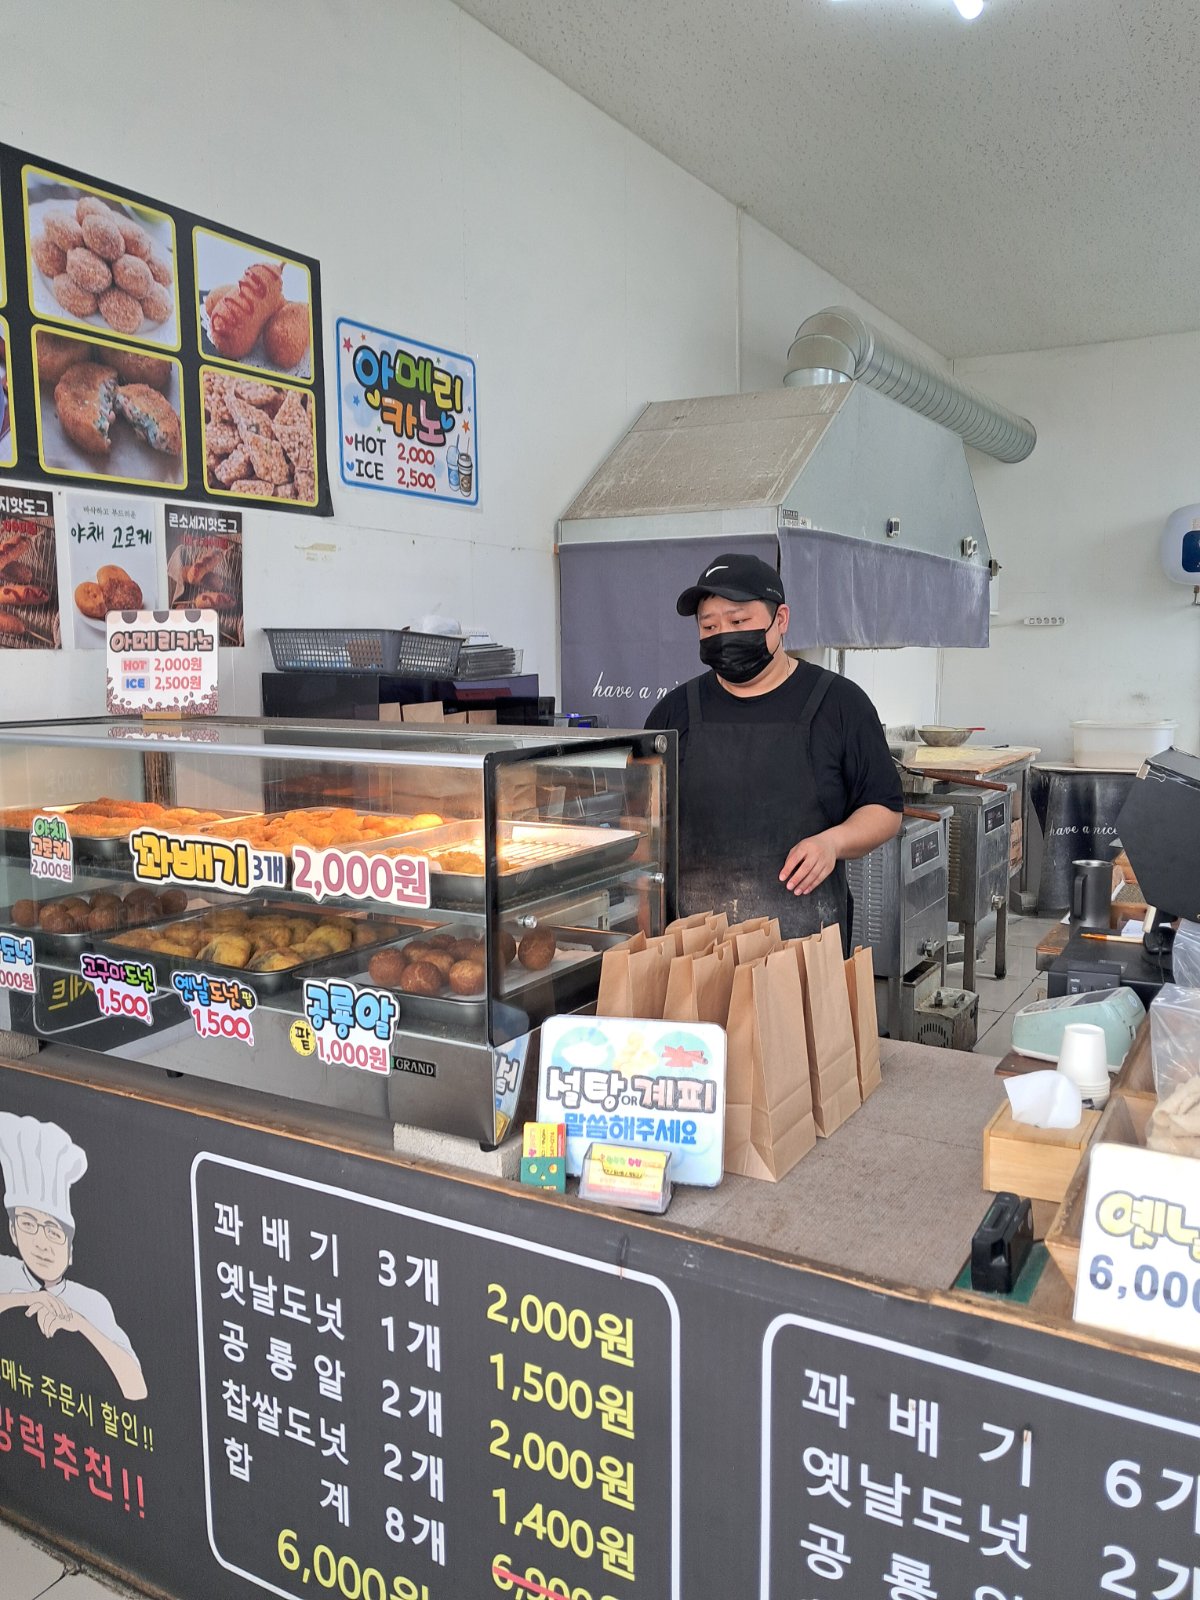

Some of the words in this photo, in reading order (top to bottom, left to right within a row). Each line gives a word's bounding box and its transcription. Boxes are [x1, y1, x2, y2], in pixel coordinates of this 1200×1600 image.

[355, 434, 386, 456] HOT
[355, 459, 384, 480] ICE
[71, 522, 104, 544] 야채
[112, 525, 152, 549] 고로케
[110, 629, 214, 652] 아메리카노
[123, 660, 147, 672] HOT
[154, 657, 202, 672] 2,000원
[125, 677, 146, 689] ICE
[154, 675, 202, 690] 2,500원
[592, 671, 634, 699] have
[639, 686, 651, 699] a
[34, 817, 67, 840] 야채
[1049, 819, 1079, 836] have
[1082, 825, 1091, 834] a
[31, 836, 71, 861] 고로케
[31, 859, 72, 880] 2,000원
[132, 831, 249, 887] 꽈배기
[253, 855, 283, 884] 3개
[294, 849, 427, 904] 2,000원
[0, 935, 33, 966] 도넛
[83, 956, 155, 993] 고구마도넛
[173, 974, 242, 1010] 옛날도넛
[306, 984, 395, 1040] 공룡알
[317, 1037, 387, 1072] 1,000원
[395, 1057, 434, 1076] GRAND
[547, 1066, 628, 1111] 설탕
[634, 1075, 717, 1112] 계피
[565, 1112, 697, 1146] 말씀해주세요
[487, 1284, 634, 1367] 2,000원
[216, 1261, 345, 1341] 옛날도넛
[489, 1353, 635, 1439] 1,500원
[0, 1358, 34, 1398] 메뉴
[41, 1375, 94, 1427] 주문시
[101, 1402, 154, 1452] 할인!!
[222, 1379, 349, 1465] 찹쌀도넛
[491, 1488, 635, 1581] 1,400원
[489, 1420, 635, 1510] 2,000원
[803, 1446, 1032, 1570] 옛날도넛
